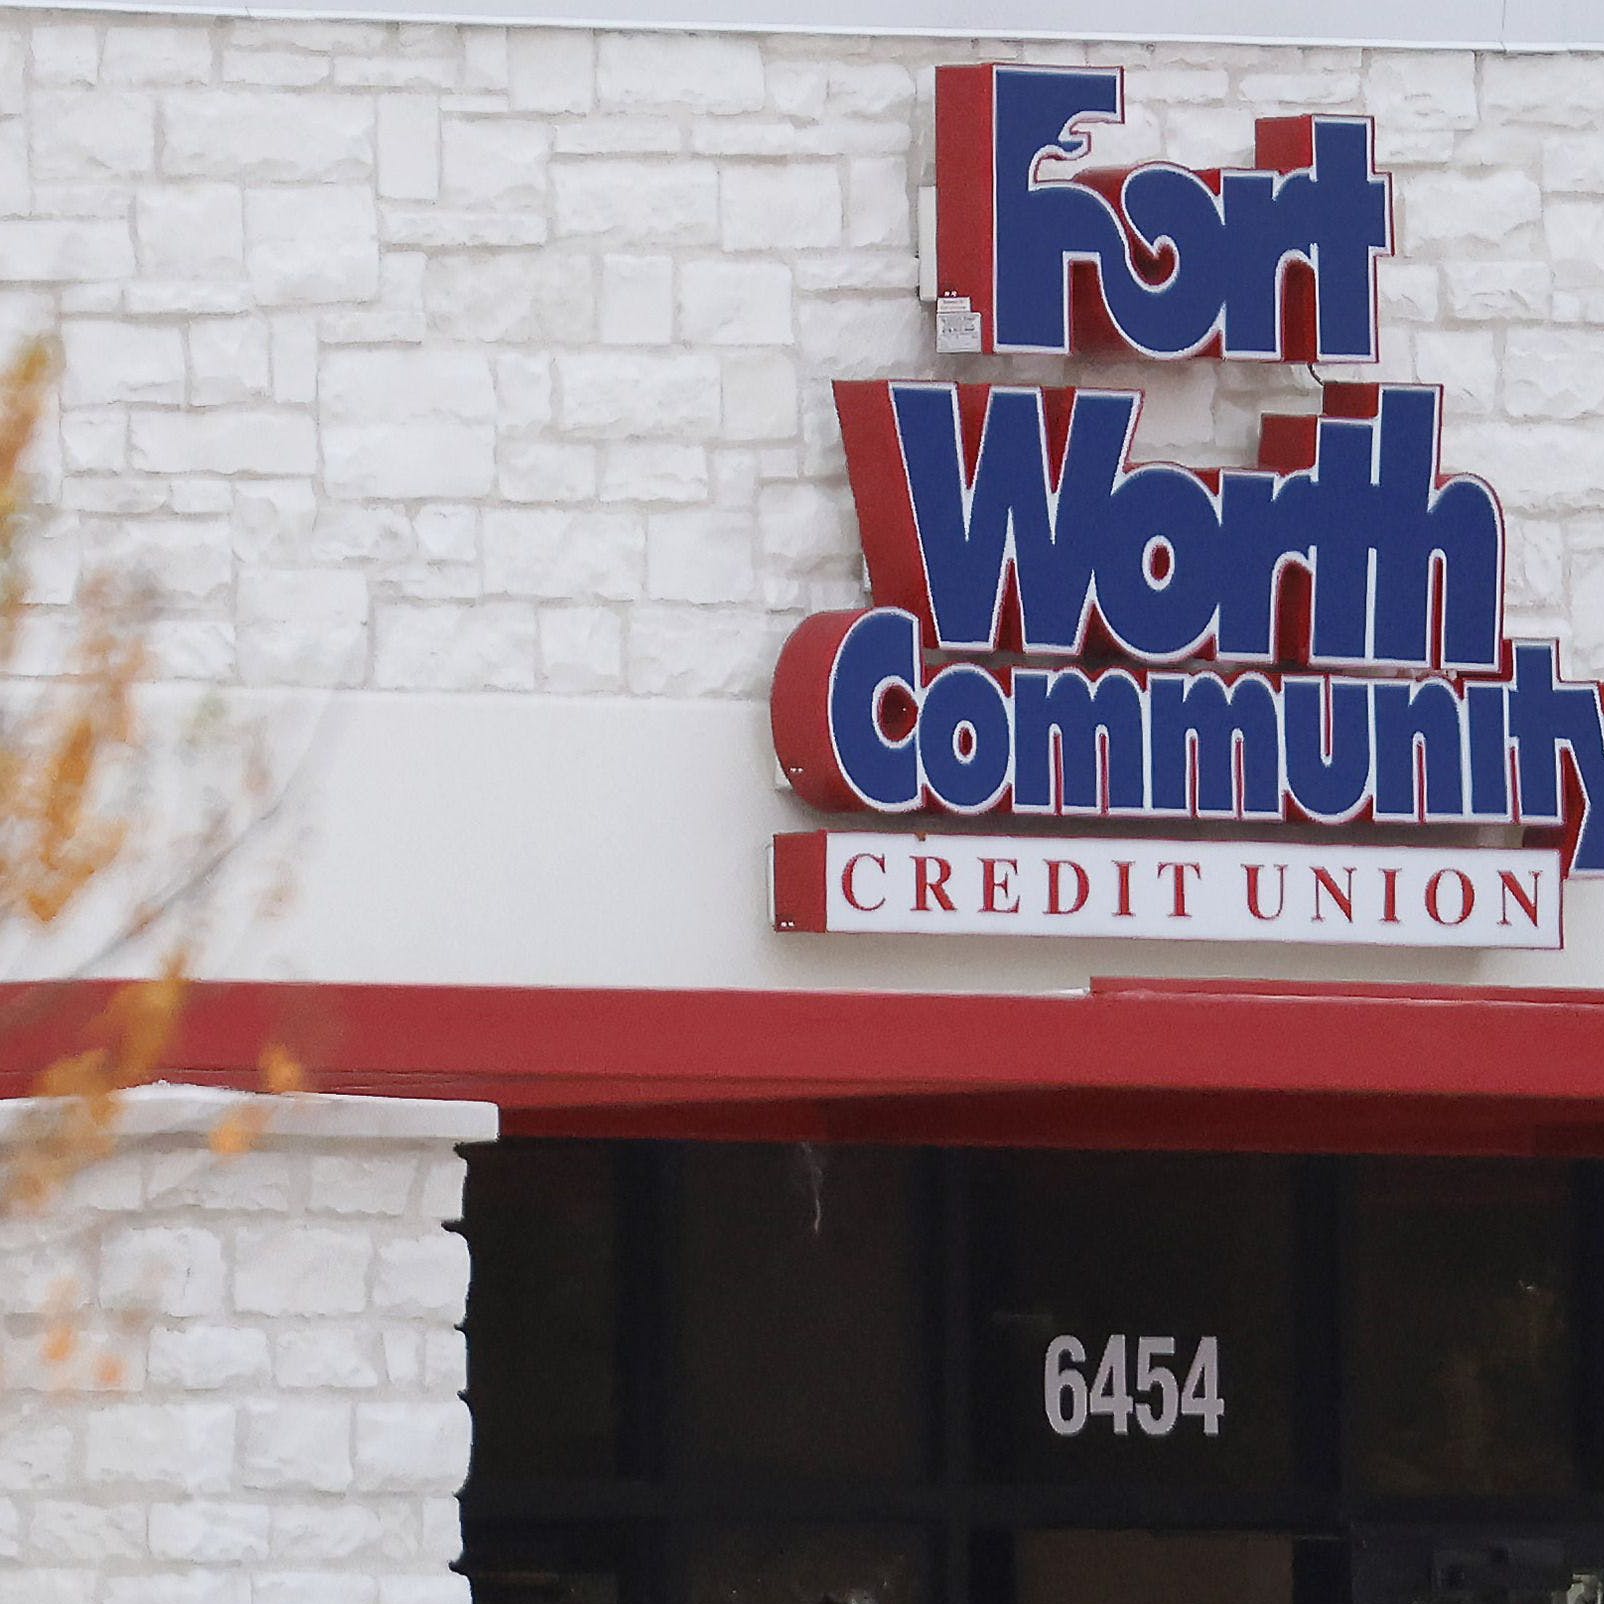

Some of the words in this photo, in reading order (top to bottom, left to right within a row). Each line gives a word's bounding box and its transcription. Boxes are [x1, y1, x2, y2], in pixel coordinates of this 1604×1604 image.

[993, 64, 1395, 364] Fort
[888, 380, 1506, 674] Worth
[840, 852, 1202, 918] CREDIT
[1239, 862, 1544, 929] UNION
[1043, 1333, 1225, 1437] 6454
